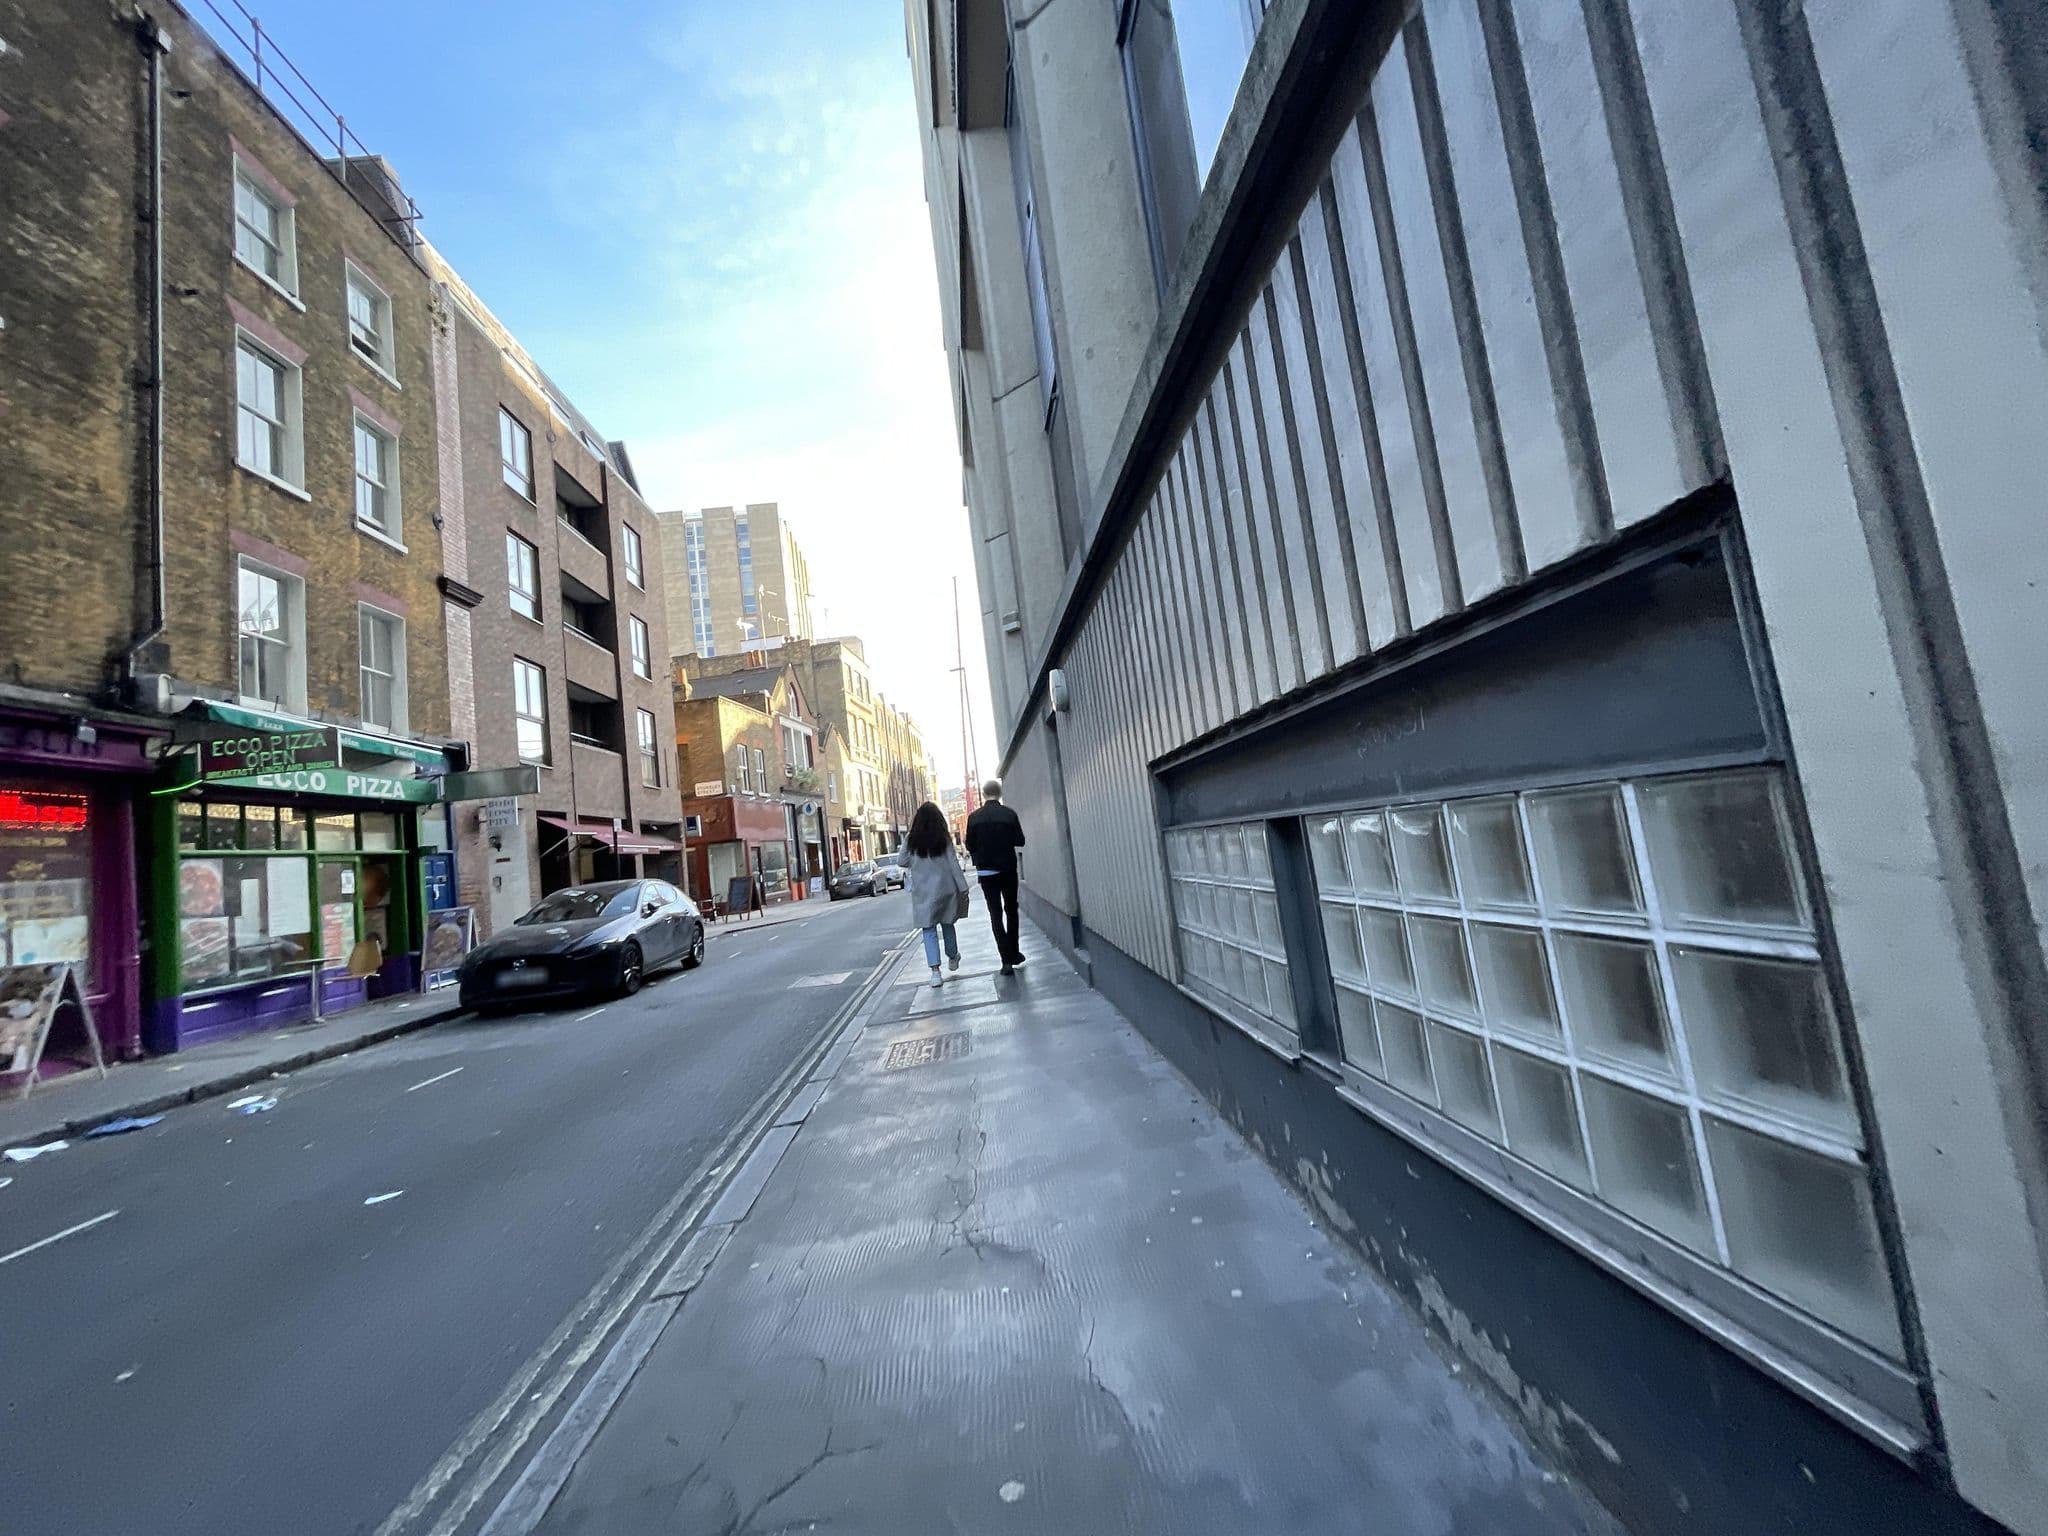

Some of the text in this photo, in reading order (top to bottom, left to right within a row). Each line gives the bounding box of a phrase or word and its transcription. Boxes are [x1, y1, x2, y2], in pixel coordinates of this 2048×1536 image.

[212, 738, 262, 757] ECCO
[270, 732, 327, 750] PIZZA
[246, 749, 296, 768] OPEN
[256, 770, 405, 799] ECCO PIZZA
